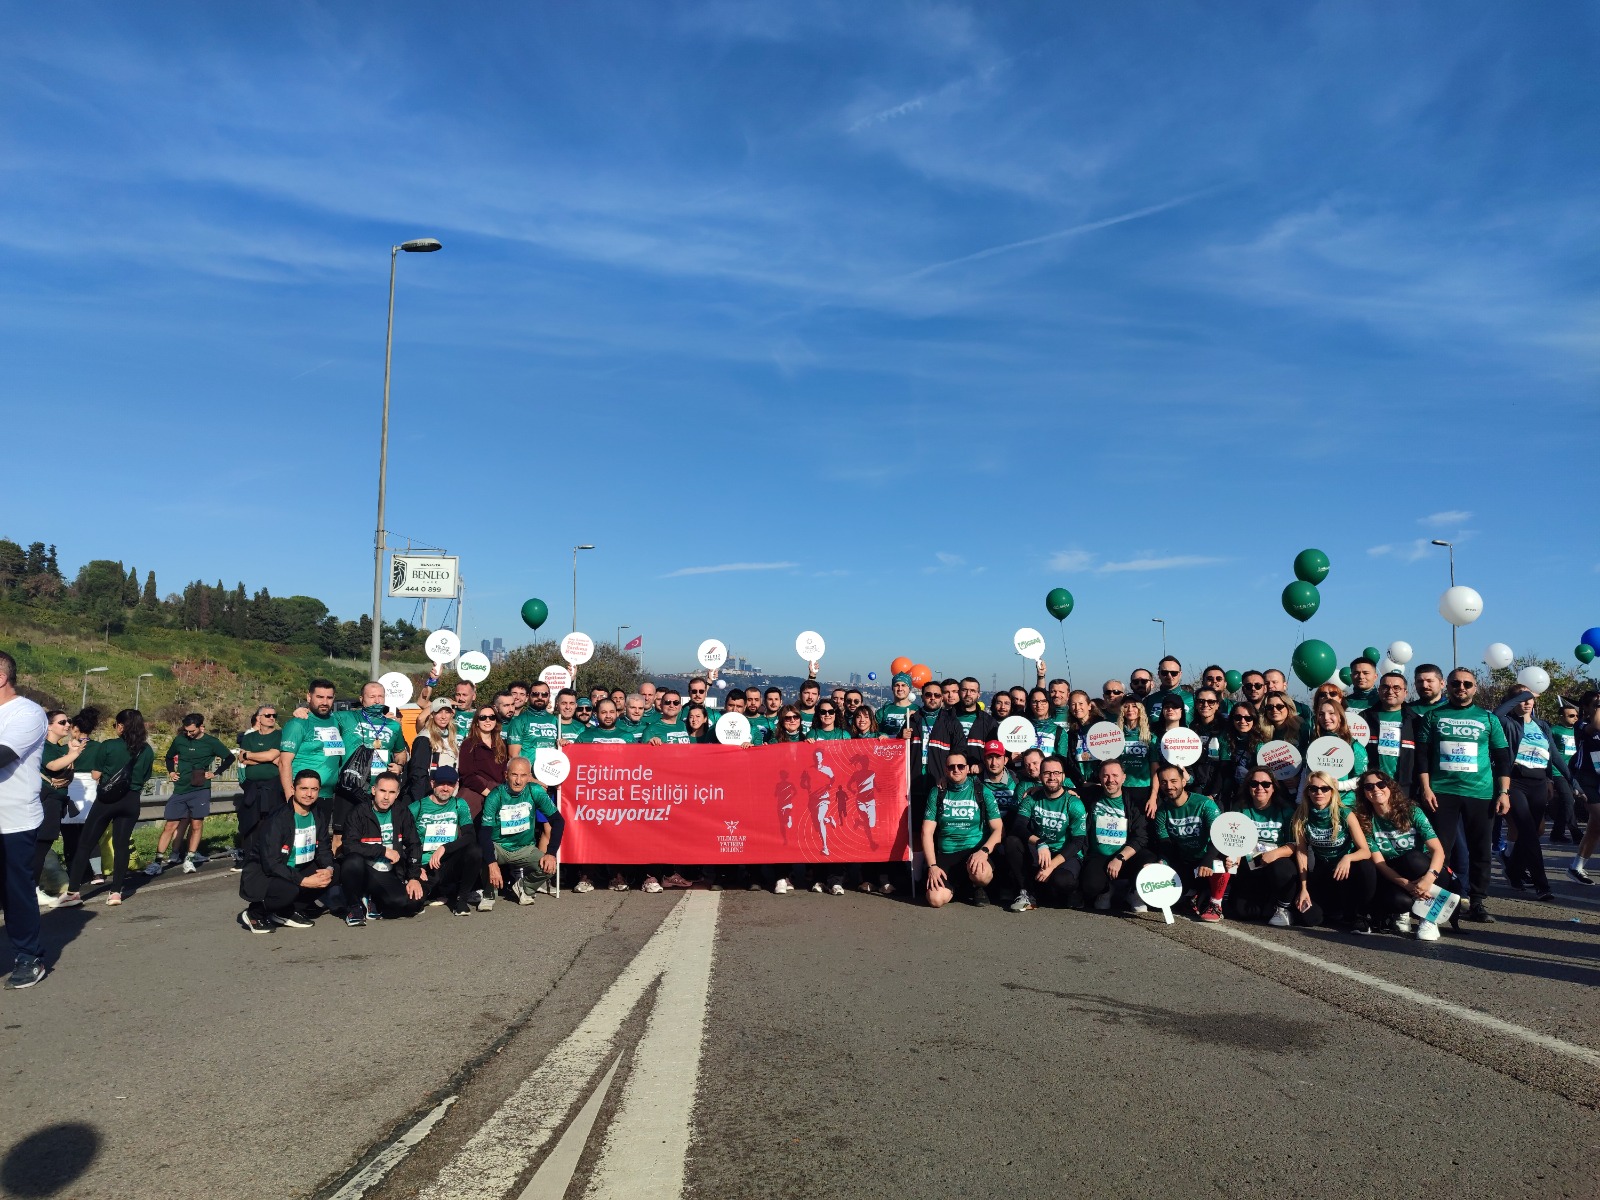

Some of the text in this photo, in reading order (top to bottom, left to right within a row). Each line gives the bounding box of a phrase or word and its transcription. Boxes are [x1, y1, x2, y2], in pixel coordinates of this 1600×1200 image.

[412, 570, 450, 579] BENLEO
[1453, 727, 1480, 740] KOŞ
[576, 765, 653, 784] Eğitimde
[575, 784, 724, 804] Fırsat Eşitliği için
[574, 805, 671, 825] Koşuyoruz!
[951, 807, 974, 820] KOŞ
[1042, 818, 1063, 832] KOŞ
